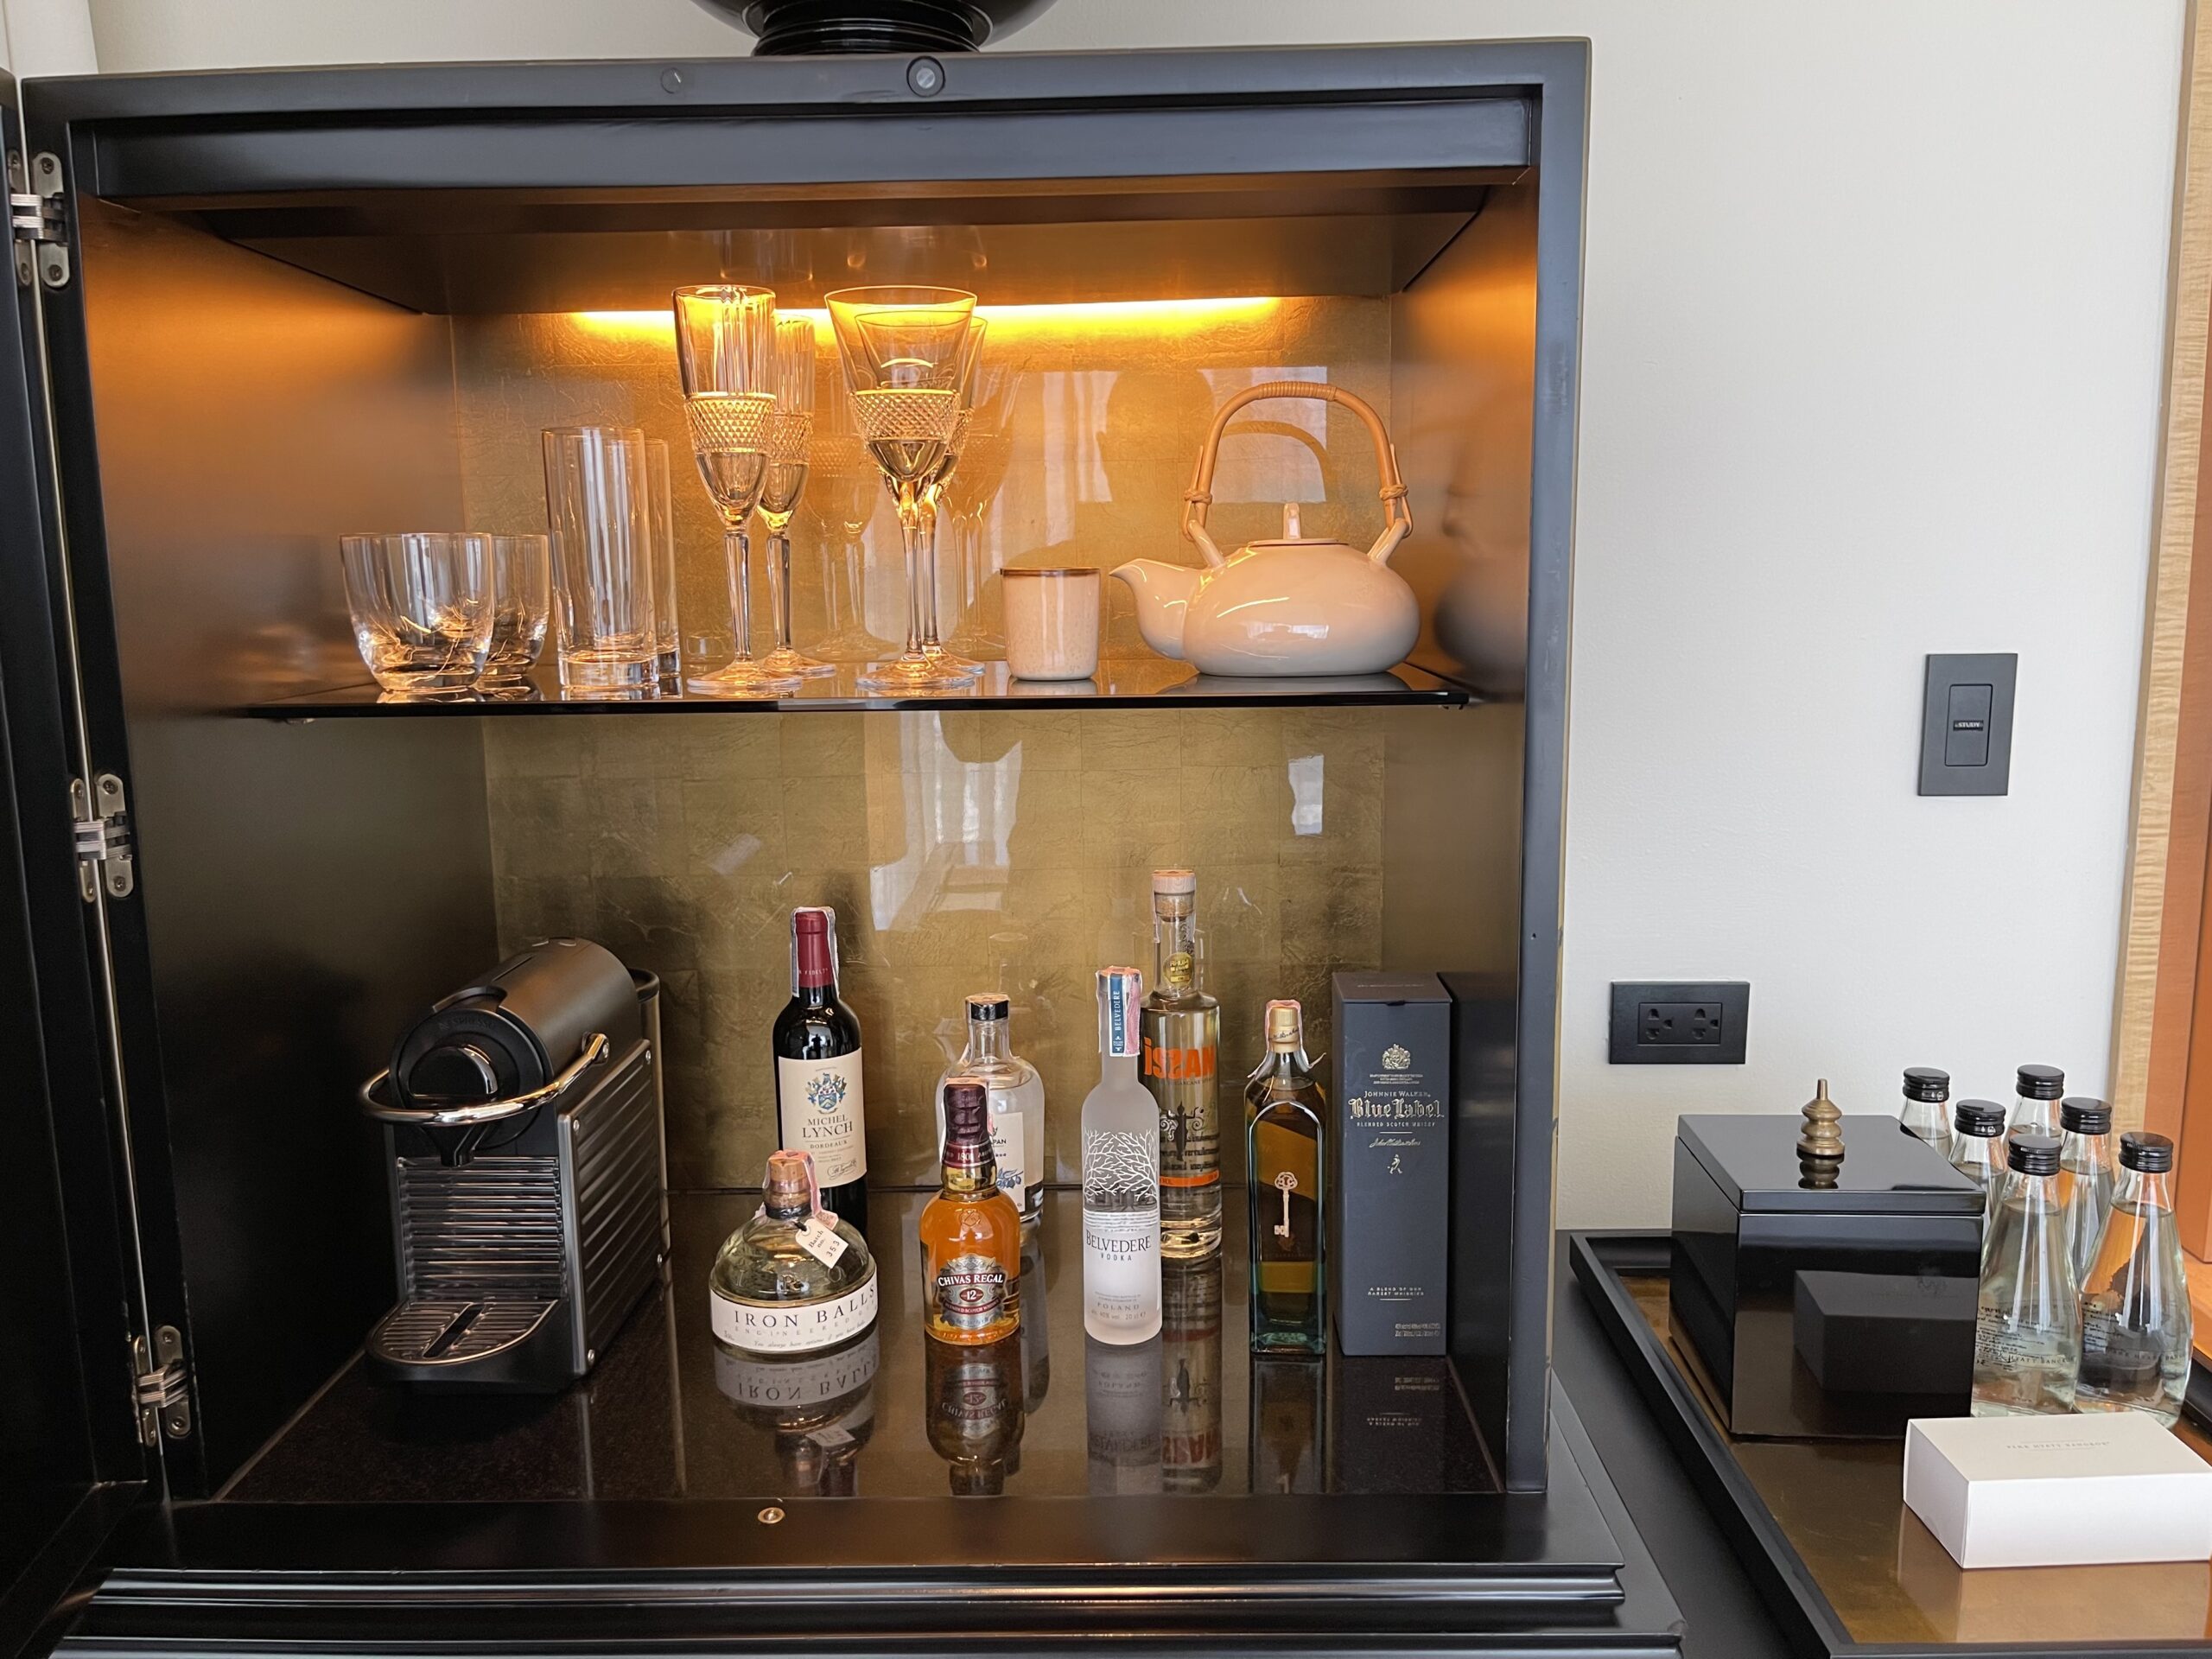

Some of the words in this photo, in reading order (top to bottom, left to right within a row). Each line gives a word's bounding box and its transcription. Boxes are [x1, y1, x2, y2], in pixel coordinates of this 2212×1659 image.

[1113, 990, 1122, 1031] BELVEDERE
[1348, 1097, 1391, 1120] Blue
[1391, 1097, 1445, 1120] Label
[808, 1114, 848, 1126] MICHEL
[802, 1121, 853, 1138] LYNCH
[810, 1140, 849, 1149] BORDEAUX
[808, 1230, 823, 1248] Batch
[1086, 1229, 1152, 1253] BELVEDERE
[826, 1240, 840, 1257] 353
[1101, 1252, 1132, 1262] VODKA
[938, 1274, 971, 1287] CHIVAS
[973, 1274, 1003, 1283] REGAL
[966, 1289, 977, 1300] 12
[734, 1309, 798, 1328] IRON
[817, 1283, 875, 1325] BALLS
